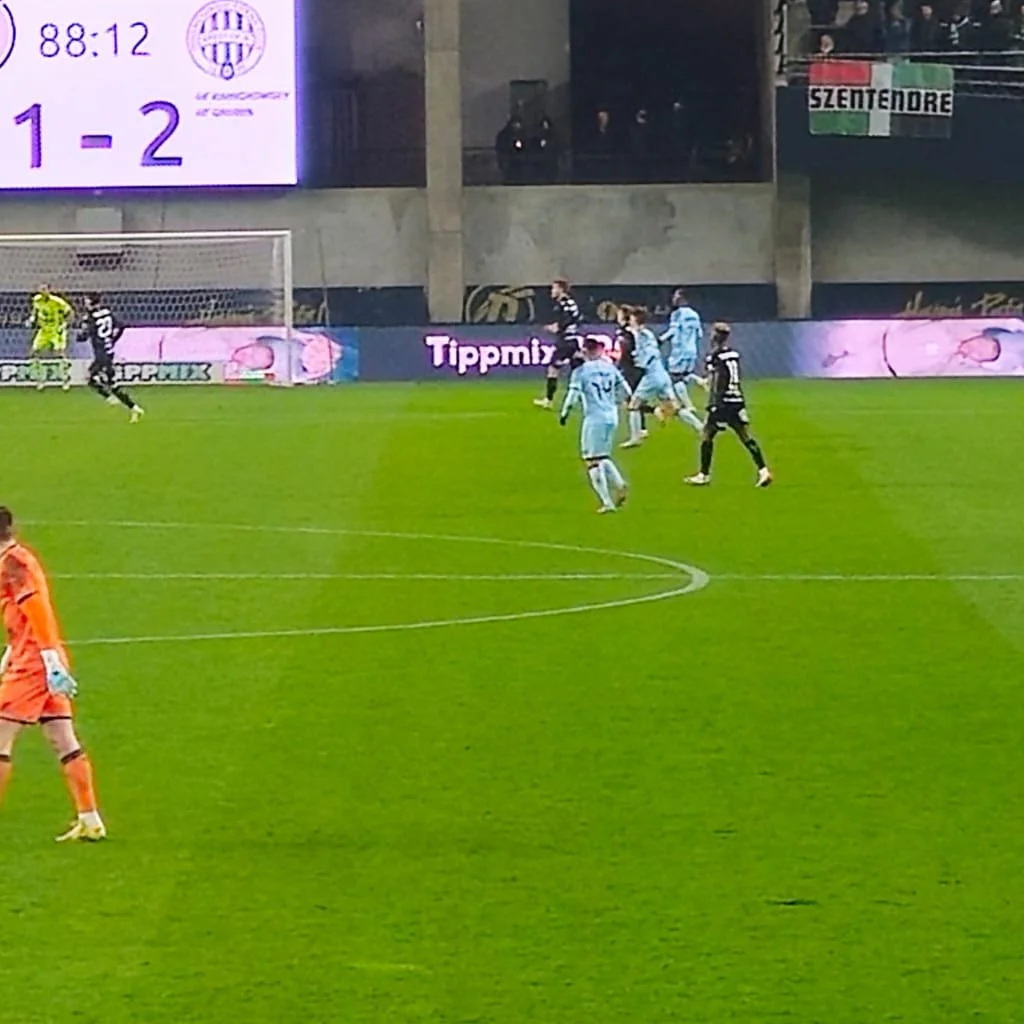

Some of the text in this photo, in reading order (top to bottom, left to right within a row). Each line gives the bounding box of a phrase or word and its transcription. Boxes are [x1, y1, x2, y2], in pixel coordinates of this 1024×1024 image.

[40, 21, 151, 58] 88:12
[14, 103, 42, 168] 1
[139, 100, 183, 167] 2
